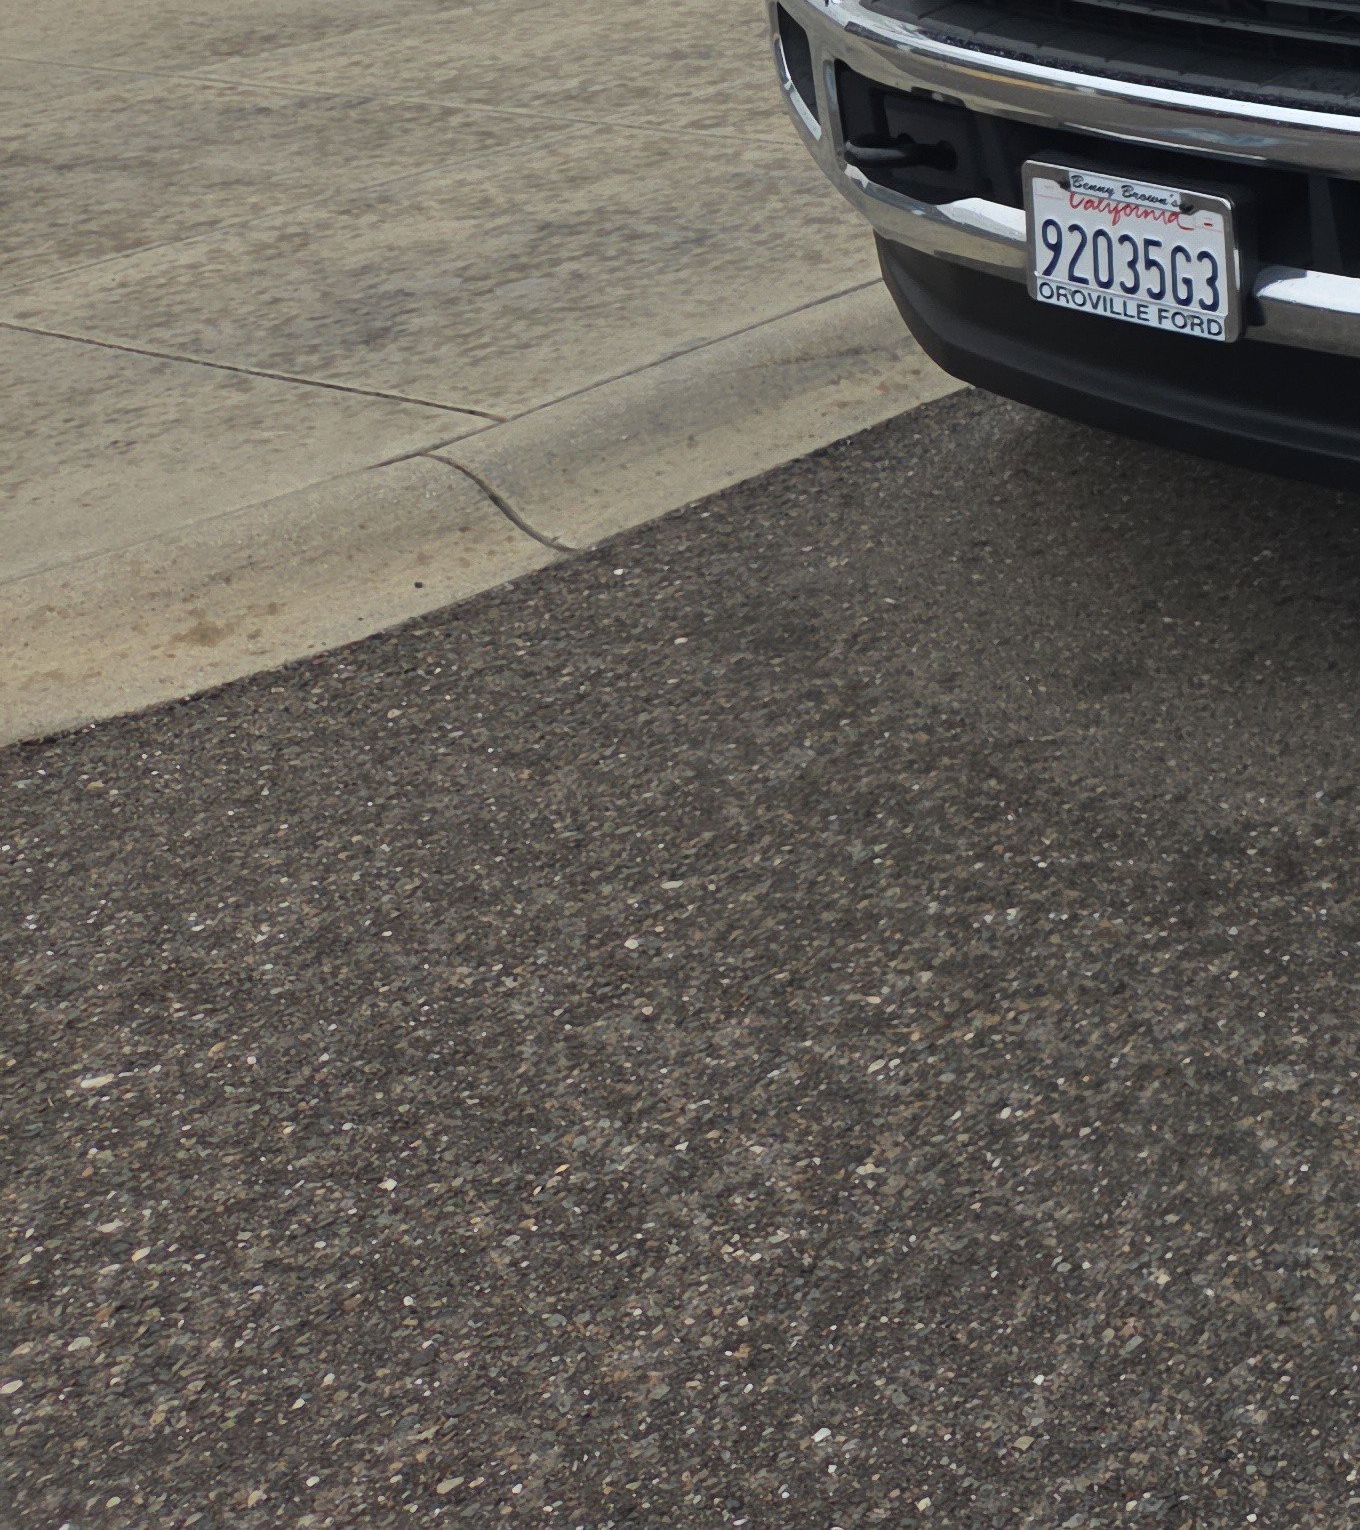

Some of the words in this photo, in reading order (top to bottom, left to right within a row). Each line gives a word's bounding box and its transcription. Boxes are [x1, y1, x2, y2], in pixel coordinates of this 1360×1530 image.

[1069, 190, 1195, 230] California
[1071, 174, 1116, 199] Benny
[1121, 184, 1181, 208] Brown's
[1041, 218, 1220, 313] 92035G3
[1038, 281, 1150, 321] OROVILLE
[1157, 308, 1223, 337] FORD
